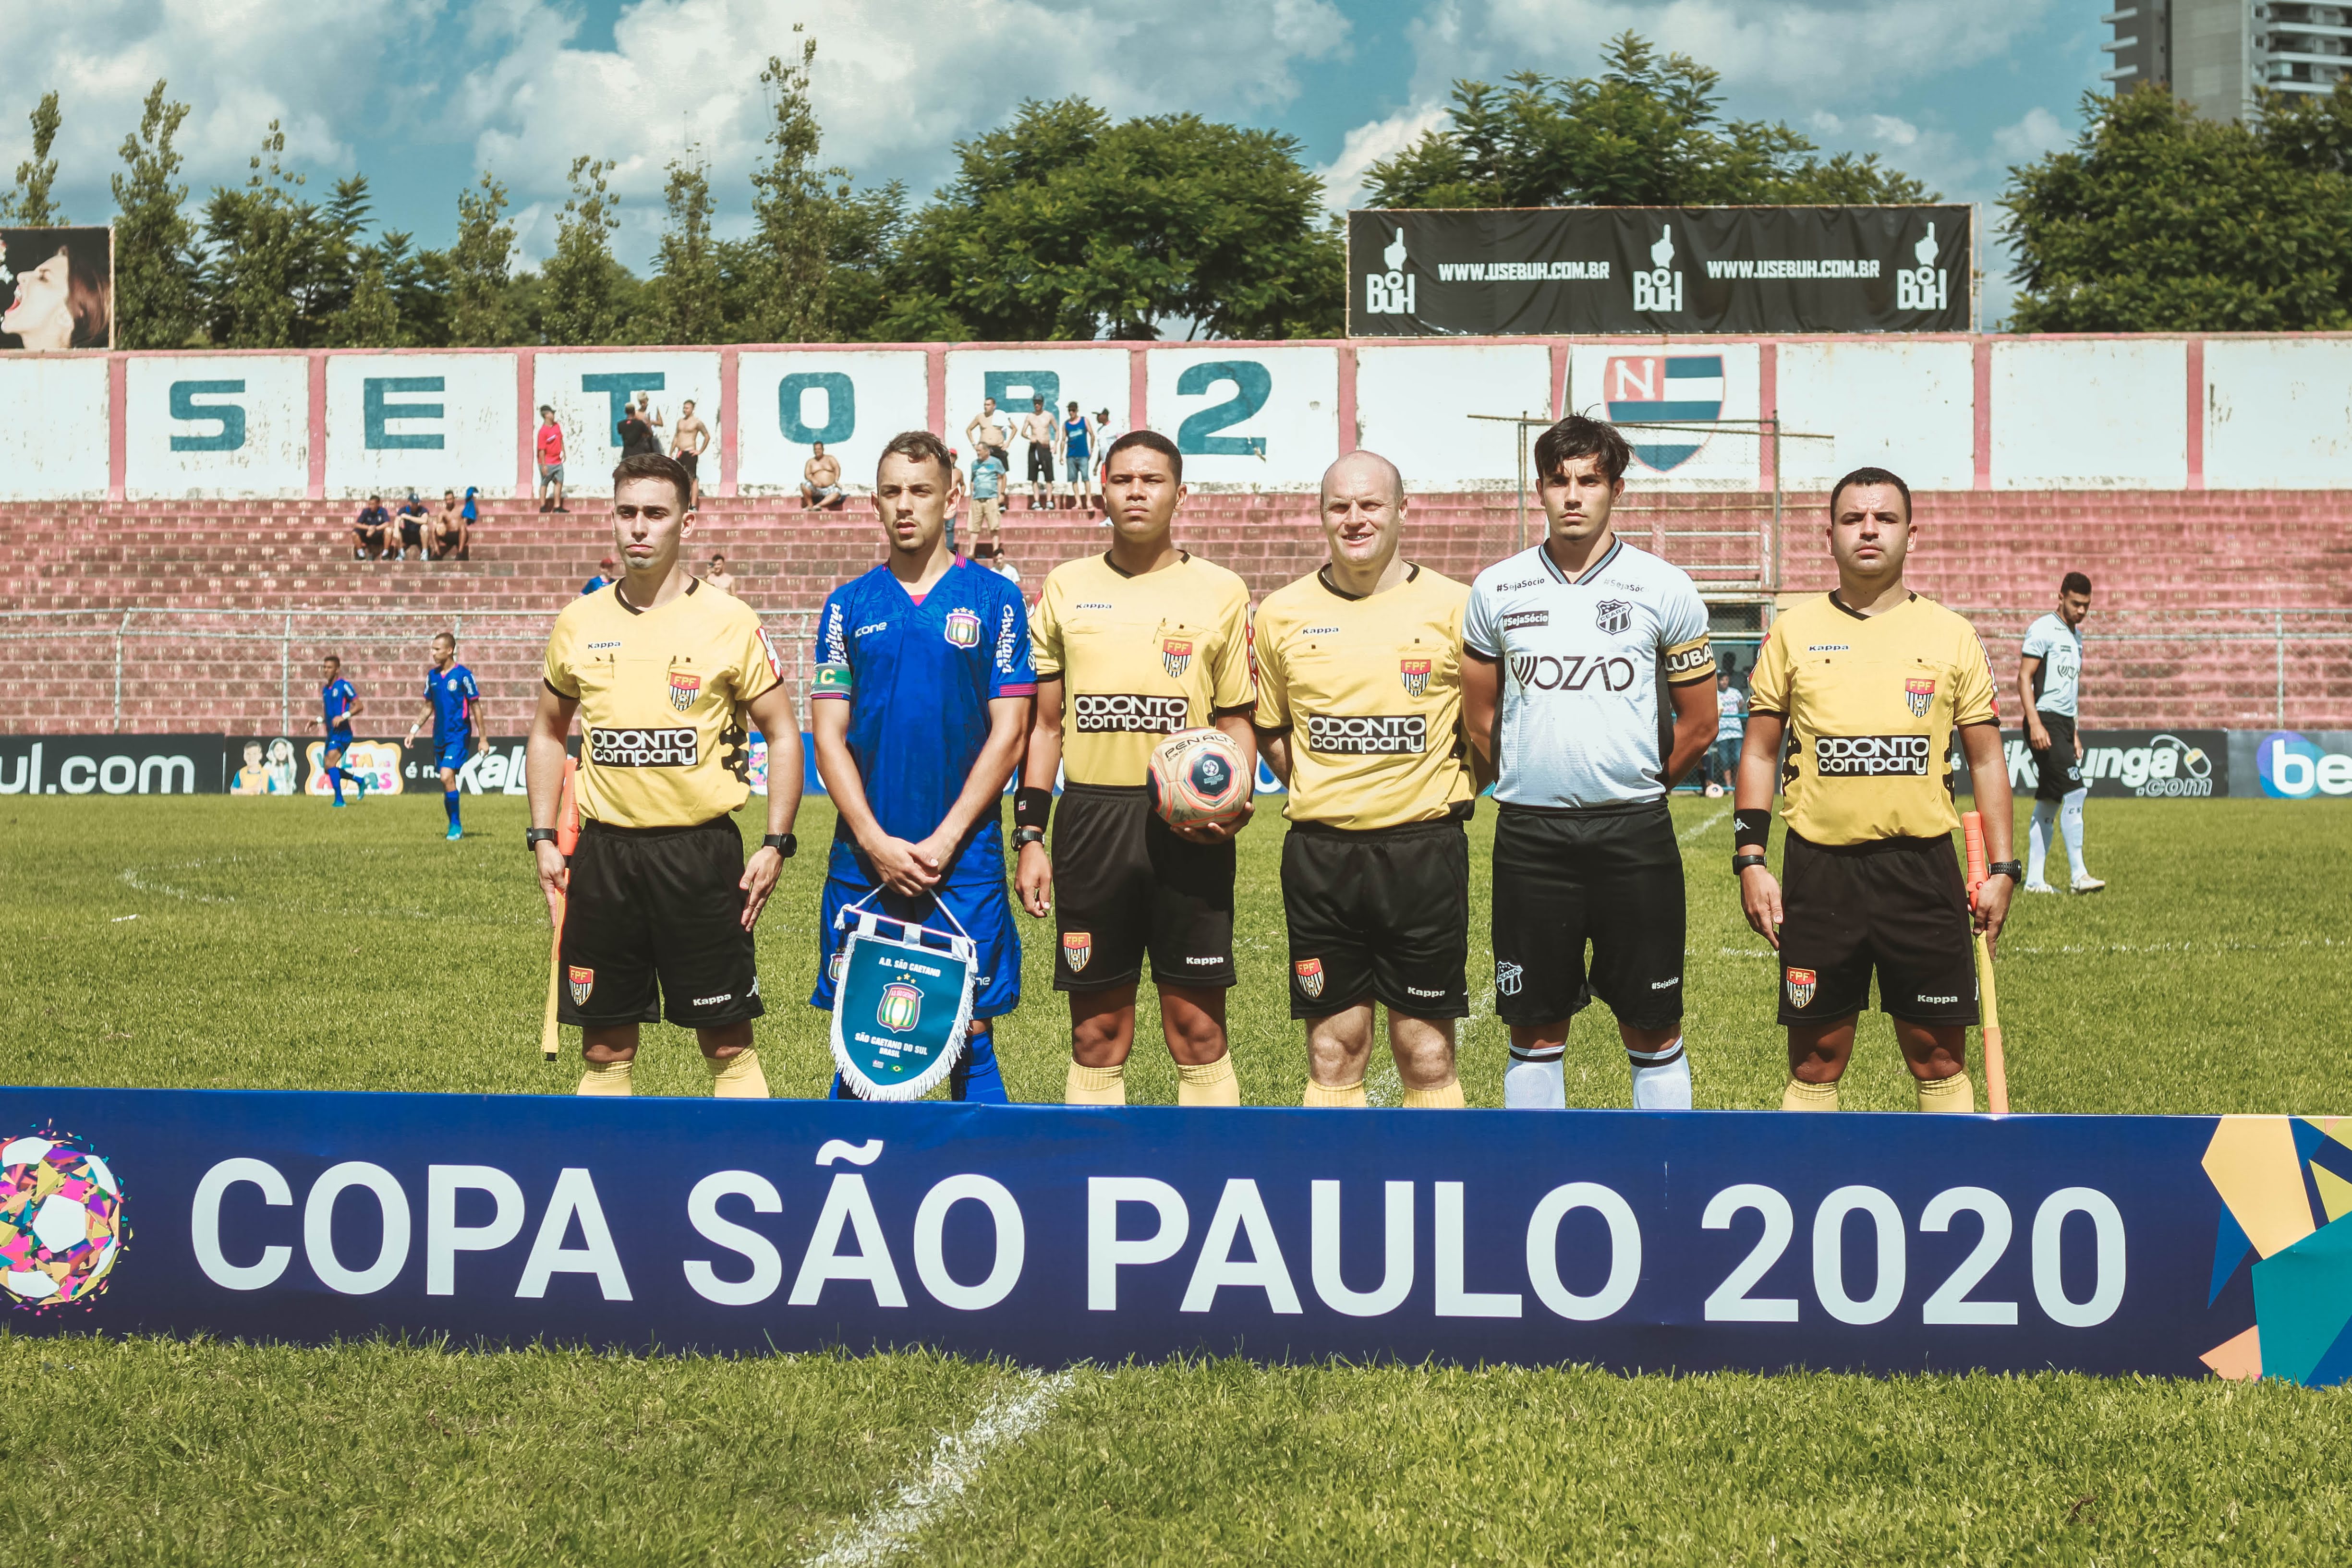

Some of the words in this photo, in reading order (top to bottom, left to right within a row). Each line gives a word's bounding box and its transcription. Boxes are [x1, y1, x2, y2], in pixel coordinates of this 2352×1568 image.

[1438, 261, 1610, 282] WWW.USEBUH.COM.BR
[1707, 259, 1880, 278] WWW.USEBUH.COM.BR
[1614, 358, 1656, 400] N
[1176, 360, 1272, 456] 2
[1497, 578, 1545, 592] #SejaSócio
[1503, 613, 1549, 627] #SejaSócio
[1167, 641, 1190, 652] FPF
[1404, 661, 1427, 671] FPF
[674, 675, 697, 686] FPF
[820, 668, 836, 685] C
[1909, 680, 1932, 690] FPF
[1075, 696, 1188, 717] ODONTO
[1077, 713, 1185, 734] company
[1307, 716, 1426, 736] ODONTO
[591, 729, 697, 749] ODONTO
[1310, 735, 1425, 754] company
[1816, 737, 1929, 757] ODONTO
[592, 747, 697, 767] company
[1819, 756, 1928, 775] company
[1066, 936, 1084, 946] FPF
[894, 959, 908, 970] SÃO
[909, 963, 941, 977] CAETANO
[1186, 955, 1224, 966] Kappa
[1298, 962, 1315, 973] FPF
[570, 969, 588, 981] FPF
[1789, 971, 1810, 982] FPF
[693, 993, 731, 1006] Kappa
[1407, 986, 1445, 998] Kappa
[1917, 994, 1958, 1004] Kappa
[855, 1032, 870, 1043] SÃO
[871, 1036, 902, 1051] CAETANO
[903, 1042, 914, 1052] DO
[914, 1044, 928, 1055] SUL
[879, 1047, 900, 1058] BRASIL
[192, 1157, 633, 1301] COPA
[683, 1138, 1026, 1310] SÃO
[1087, 1175, 1643, 1322] PAULO
[1700, 1183, 2128, 1328] 2020
